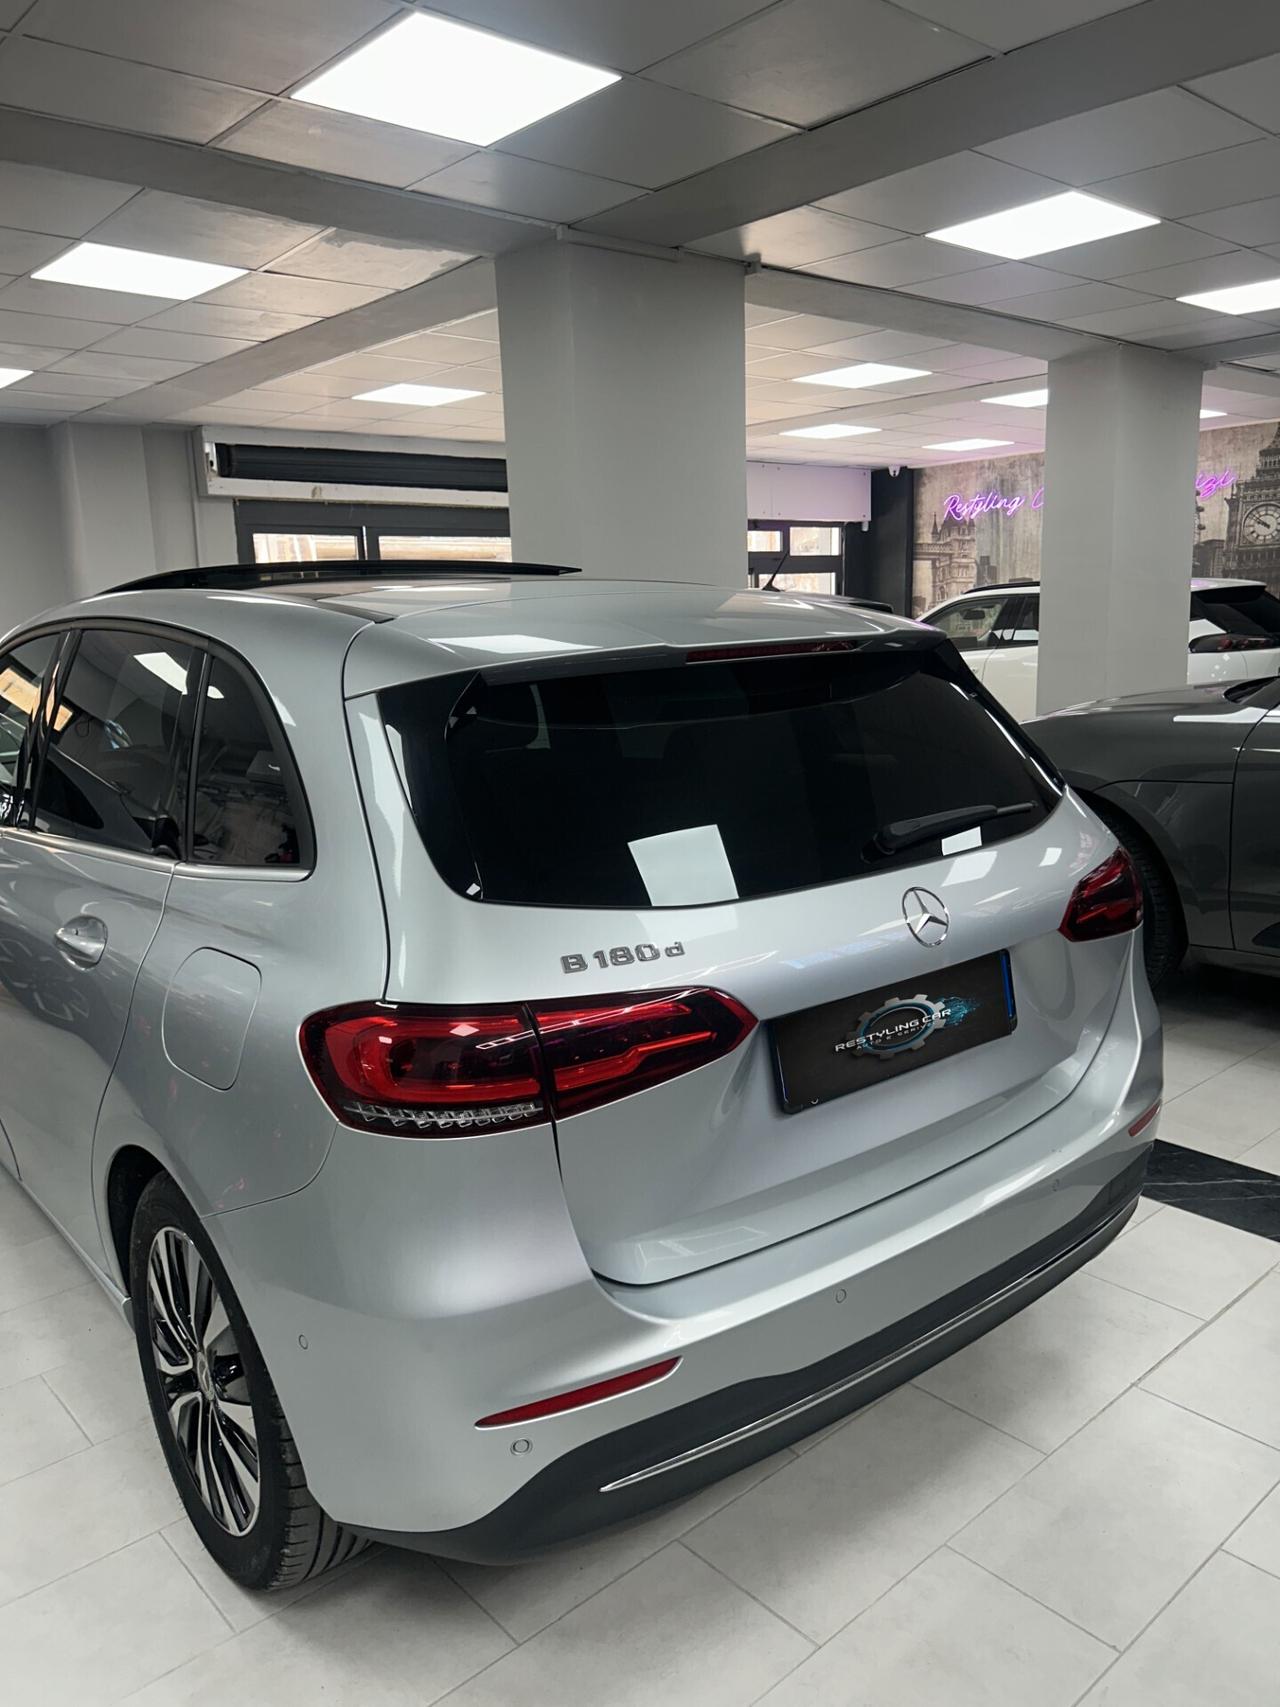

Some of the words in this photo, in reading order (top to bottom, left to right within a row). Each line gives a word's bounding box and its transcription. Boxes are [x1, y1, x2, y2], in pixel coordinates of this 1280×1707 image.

[943, 491, 1025, 521] Restyling
[834, 1019, 920, 1052] RESTYLING
[921, 1008, 952, 1022] CAR
